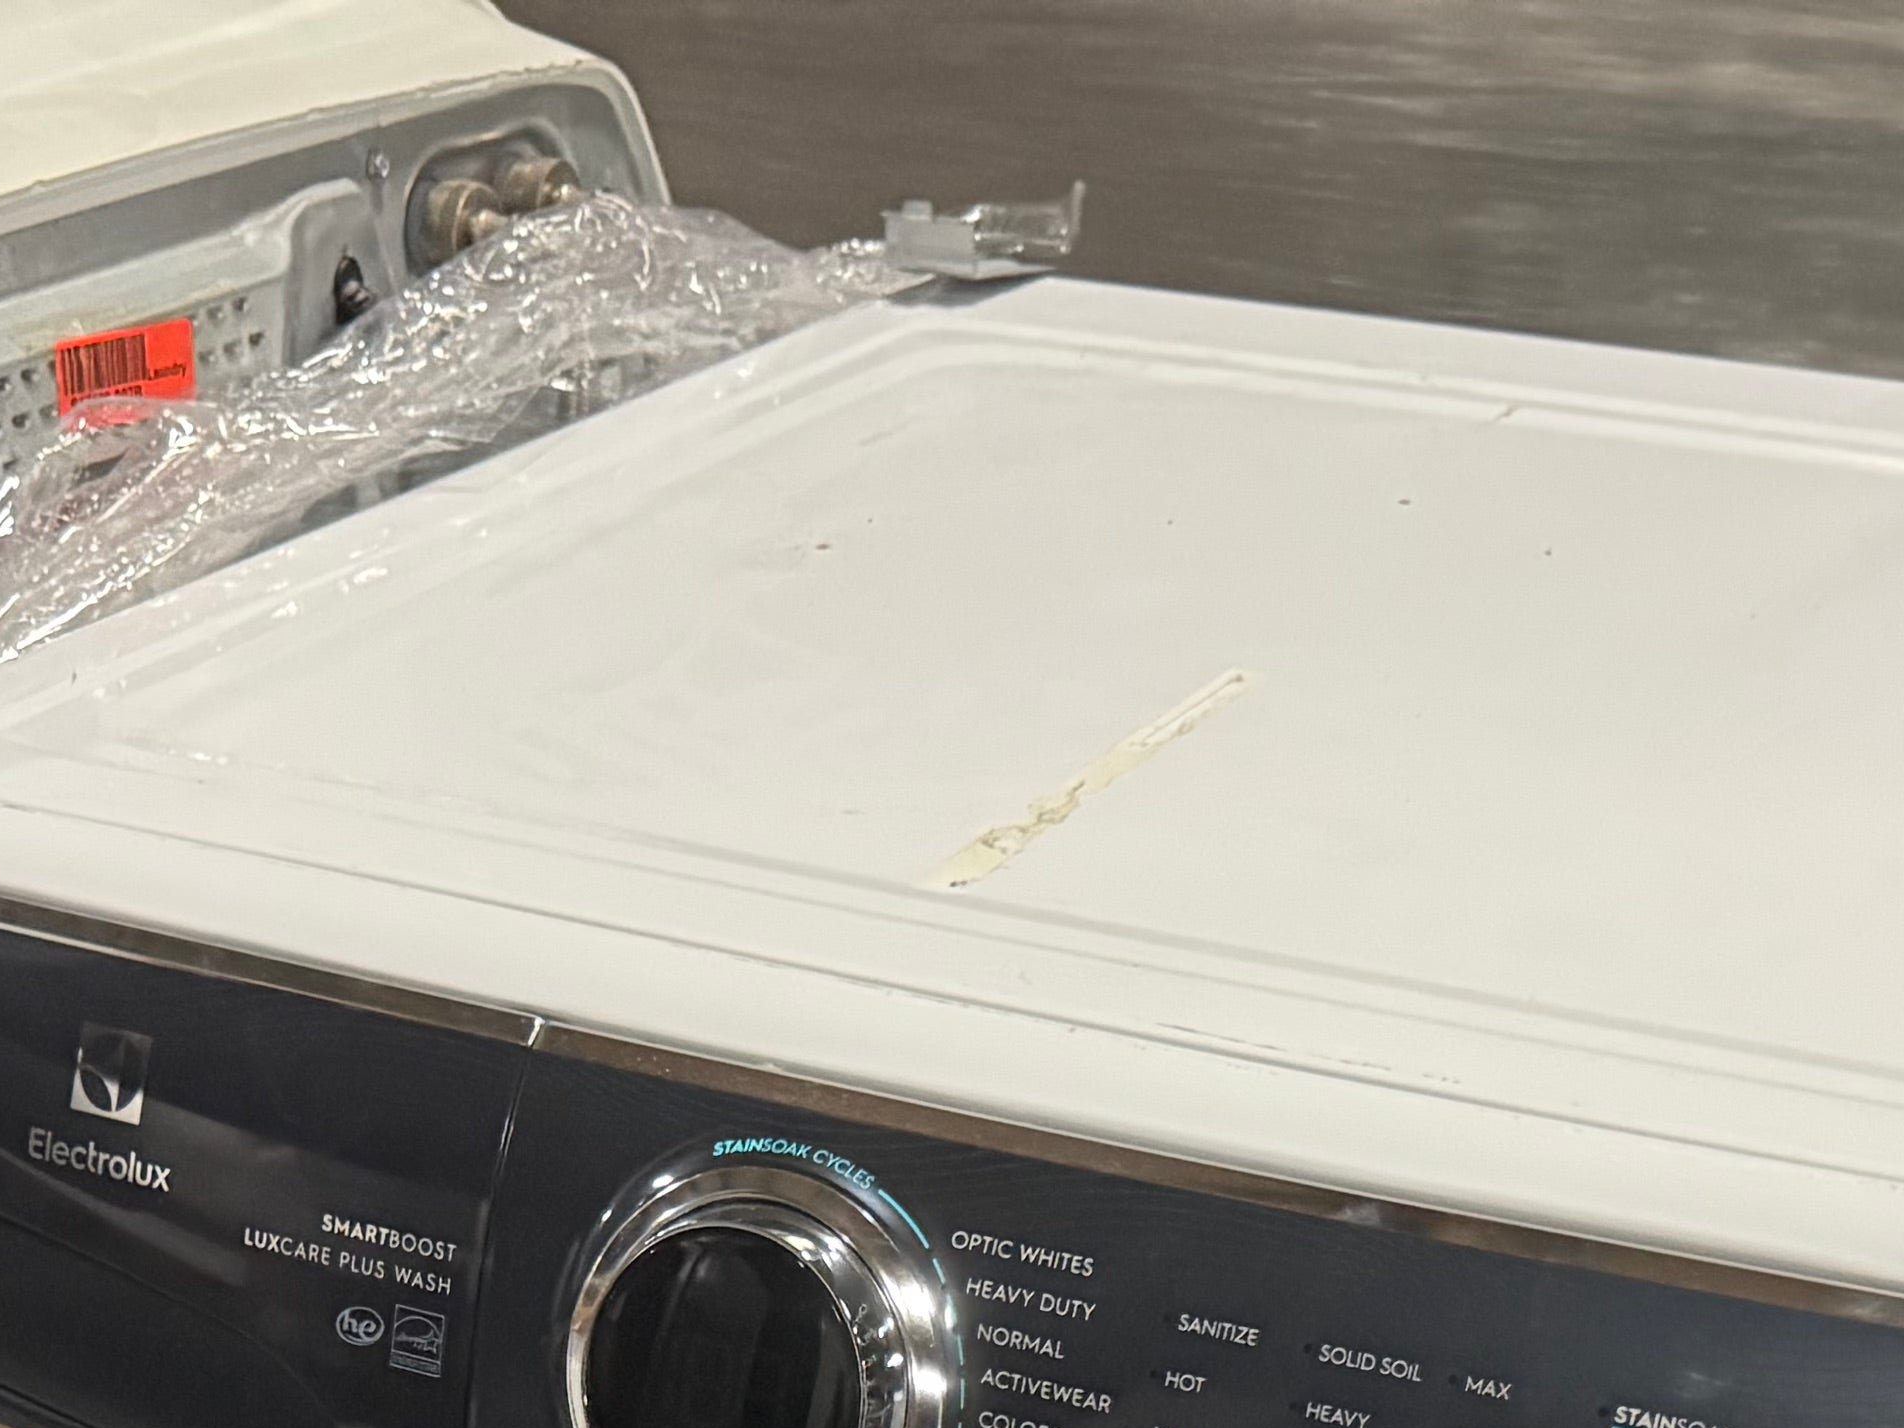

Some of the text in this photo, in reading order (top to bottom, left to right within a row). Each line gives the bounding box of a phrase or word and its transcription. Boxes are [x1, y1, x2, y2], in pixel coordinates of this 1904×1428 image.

[28, 1127, 171, 1191] Electrolux
[713, 1139, 875, 1189] STAINSOAK CYCLES
[322, 1214, 456, 1261] SMARTBOOST
[952, 1231, 1093, 1276] OPTIC WHITES
[245, 1228, 450, 1295] LUXCARE PLUS WASH
[966, 1278, 1096, 1320] HEAVY DUTY
[977, 1324, 1064, 1358] NORMAL
[1178, 1314, 1259, 1346] SANITIZE
[1165, 1371, 1206, 1392] HOT
[1319, 1344, 1421, 1381] SOLID SOIL
[981, 1369, 1111, 1413] ACTIVEWEAR
[1465, 1376, 1511, 1400] MAX
[1306, 1402, 1370, 1428] HEAVY
